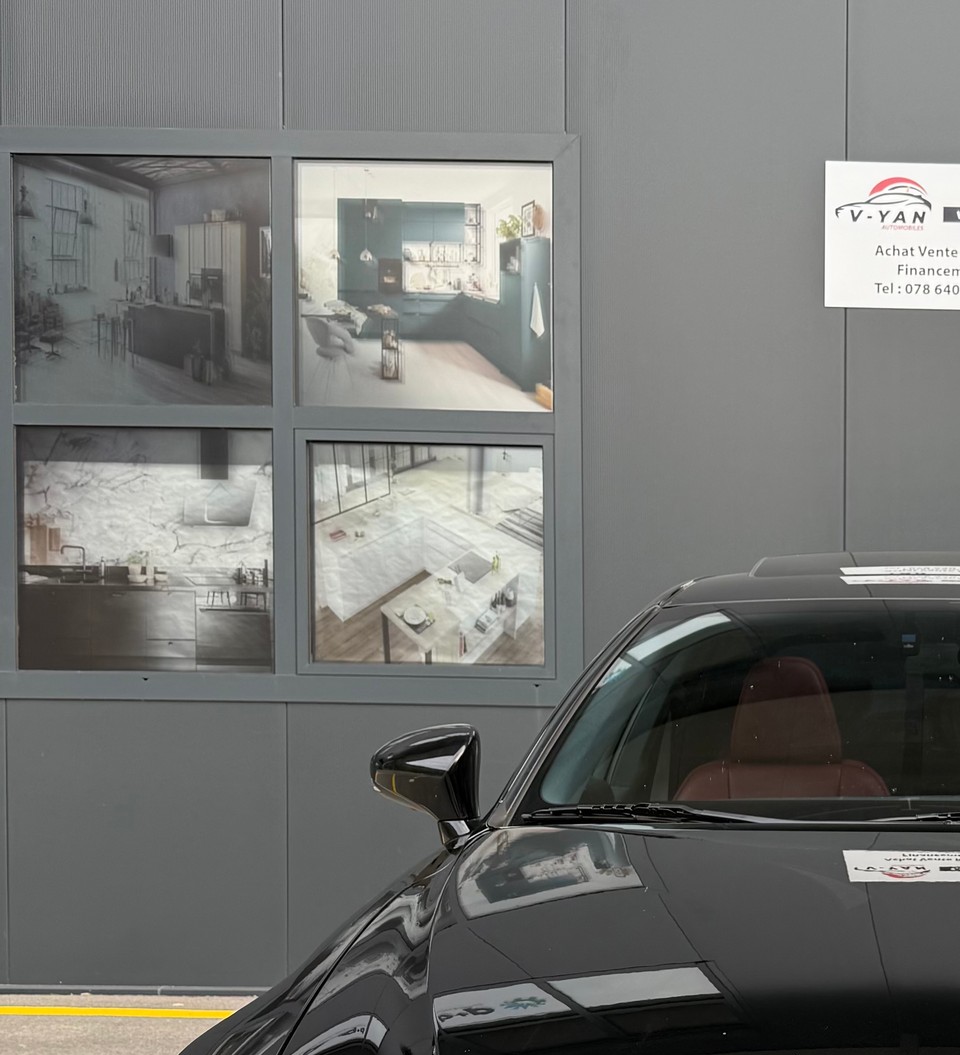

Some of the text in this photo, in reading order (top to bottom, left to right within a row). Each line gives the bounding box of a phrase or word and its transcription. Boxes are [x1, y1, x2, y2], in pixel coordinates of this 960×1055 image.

[850, 209, 926, 224] V-YAN
[875, 244, 915, 257] Achat
[918, 246, 958, 258] Vente
[874, 282, 894, 294] Tel
[905, 283, 930, 295] 078
[934, 284, 960, 296] 640
